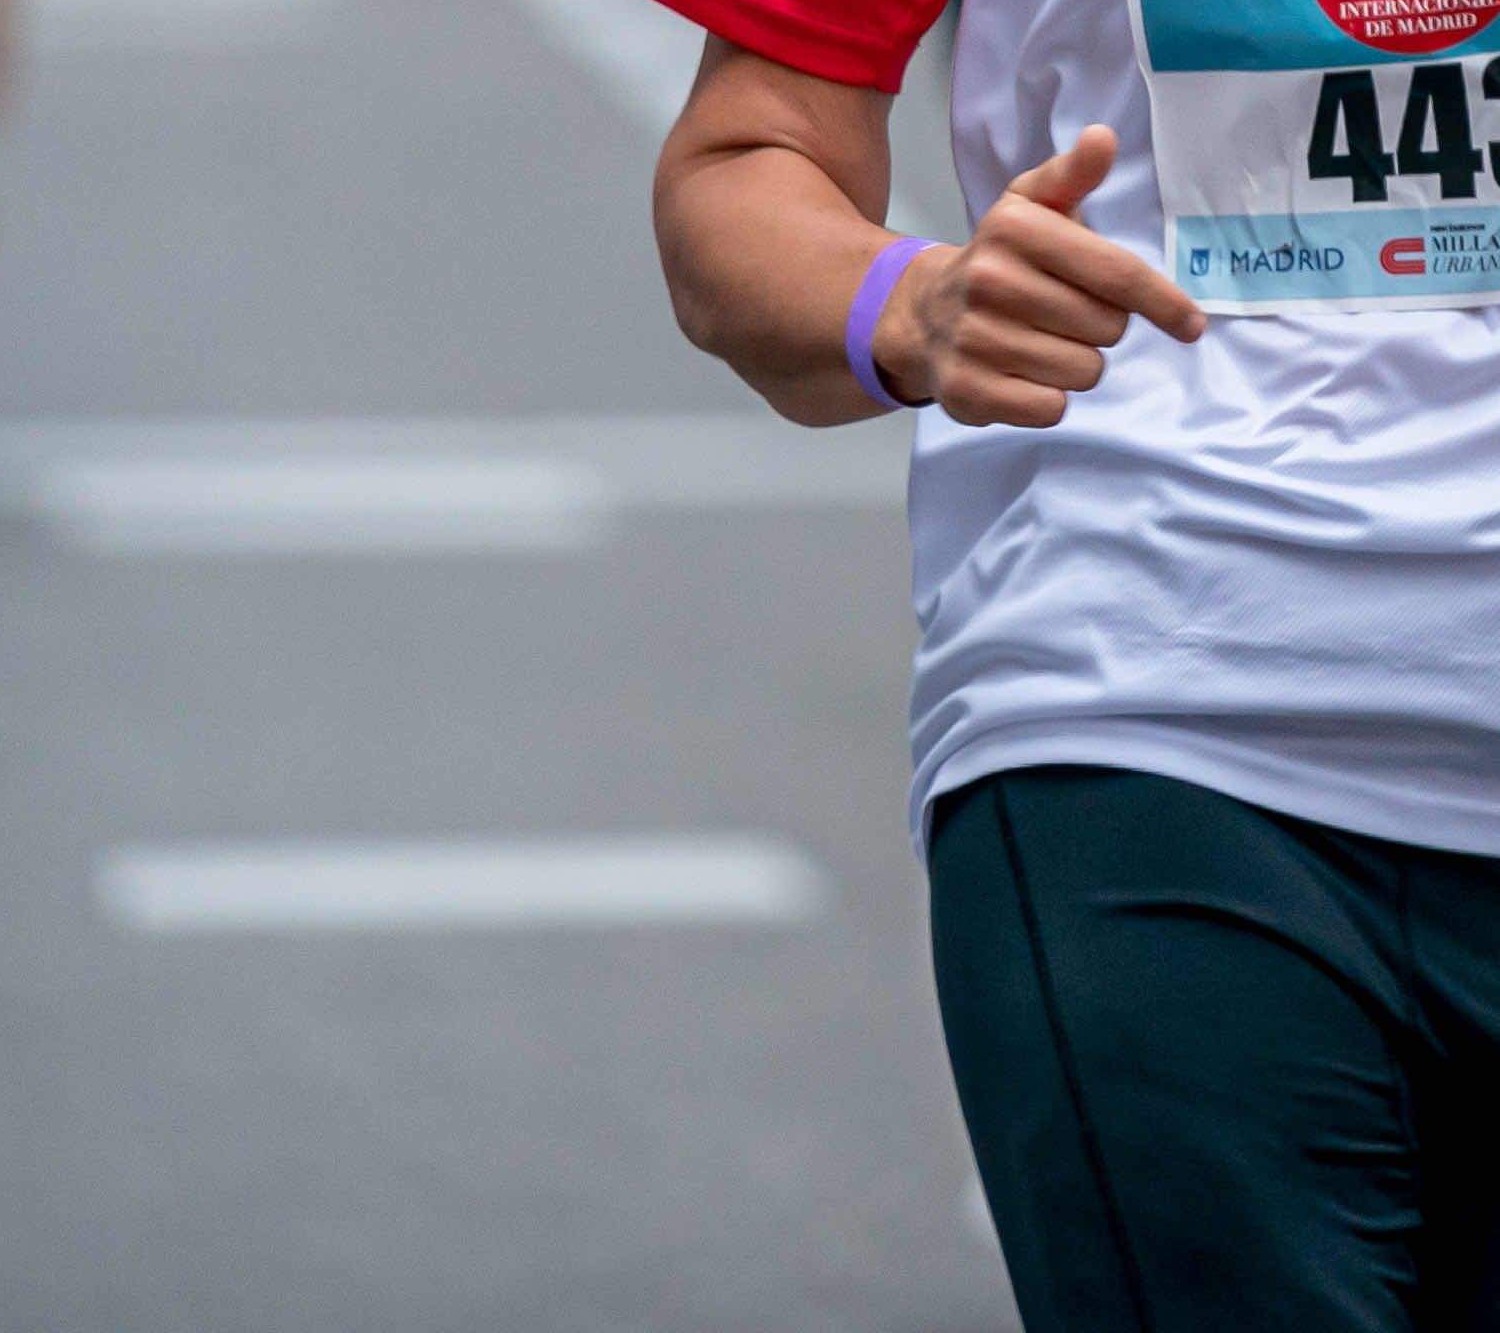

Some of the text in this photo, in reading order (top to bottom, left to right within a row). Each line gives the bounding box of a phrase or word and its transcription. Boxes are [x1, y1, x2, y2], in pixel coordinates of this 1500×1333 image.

[1364, 12, 1478, 38] DE MADRID
[1431, 234, 1500, 252] MILLA
[1230, 247, 1345, 274] MADRID
